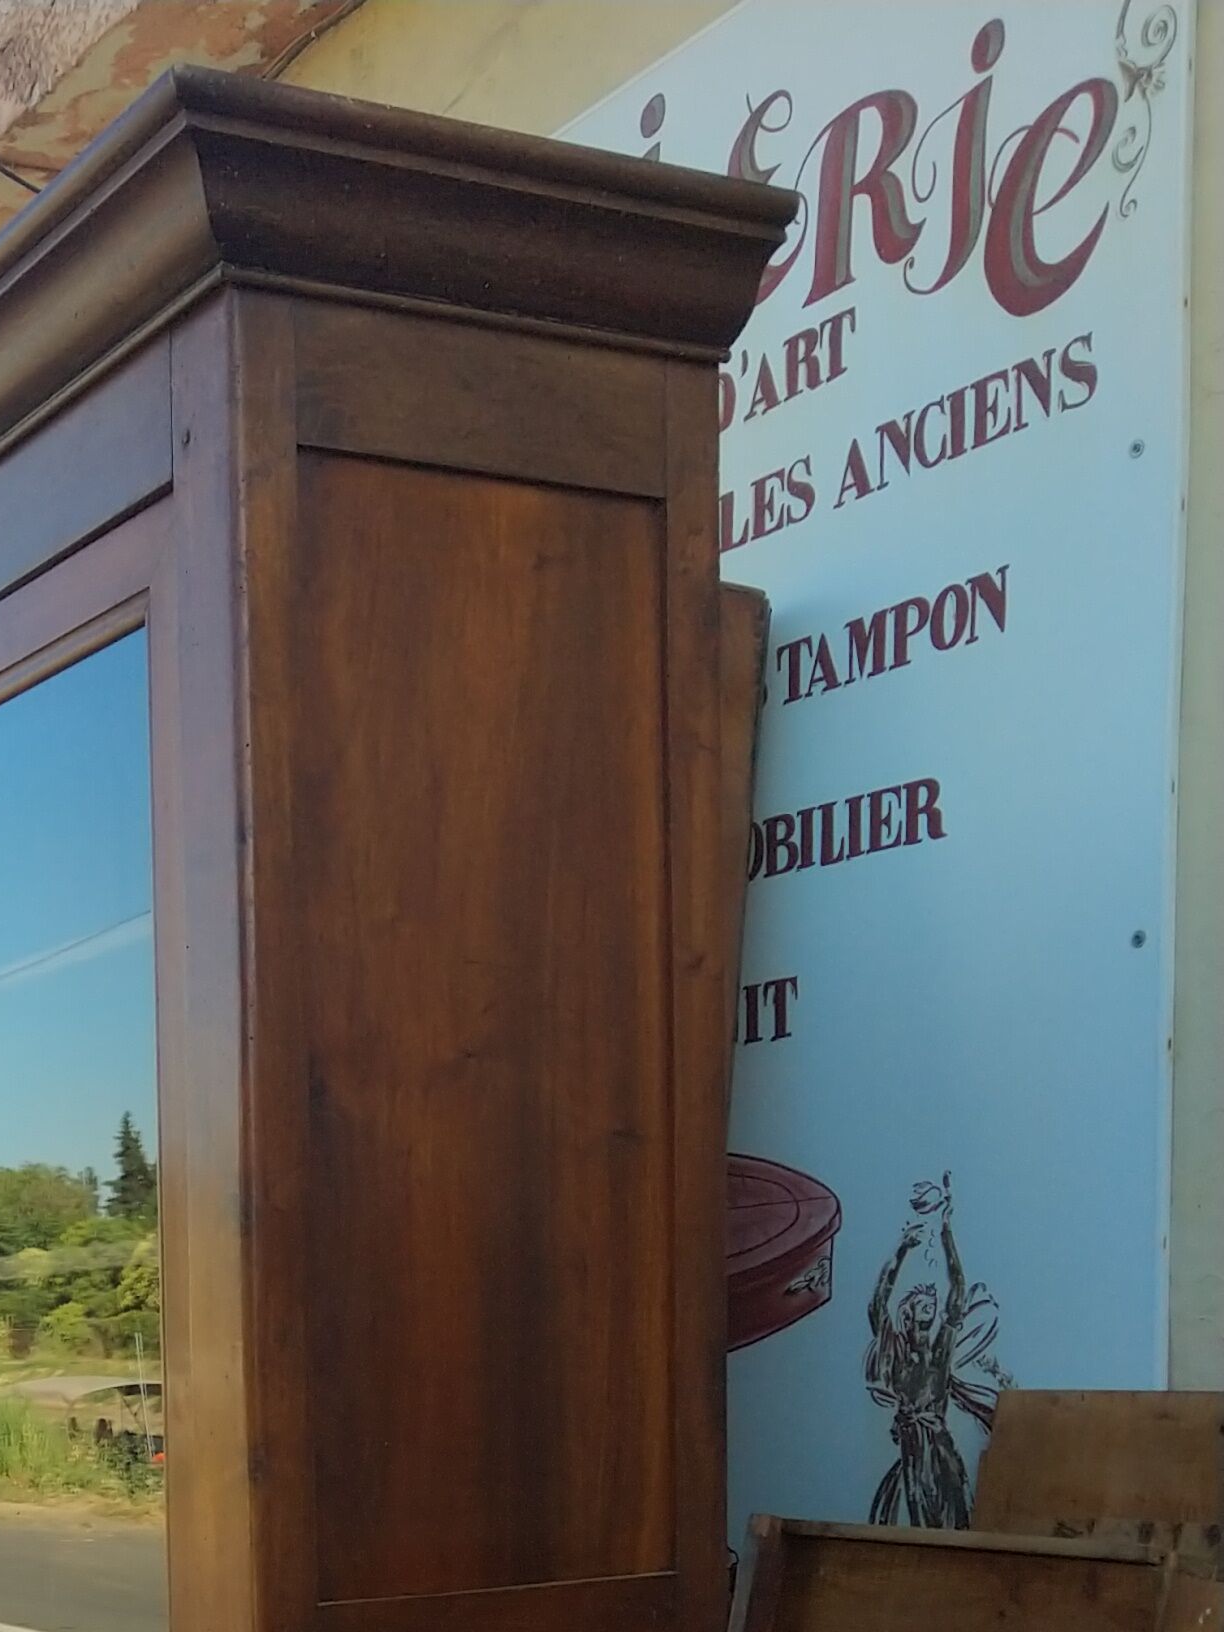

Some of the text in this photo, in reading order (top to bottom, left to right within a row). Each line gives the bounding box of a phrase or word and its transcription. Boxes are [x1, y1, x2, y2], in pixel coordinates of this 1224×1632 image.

[719, 332, 1098, 553] LES ANCIENS
[777, 564, 1010, 705] TAMPON
